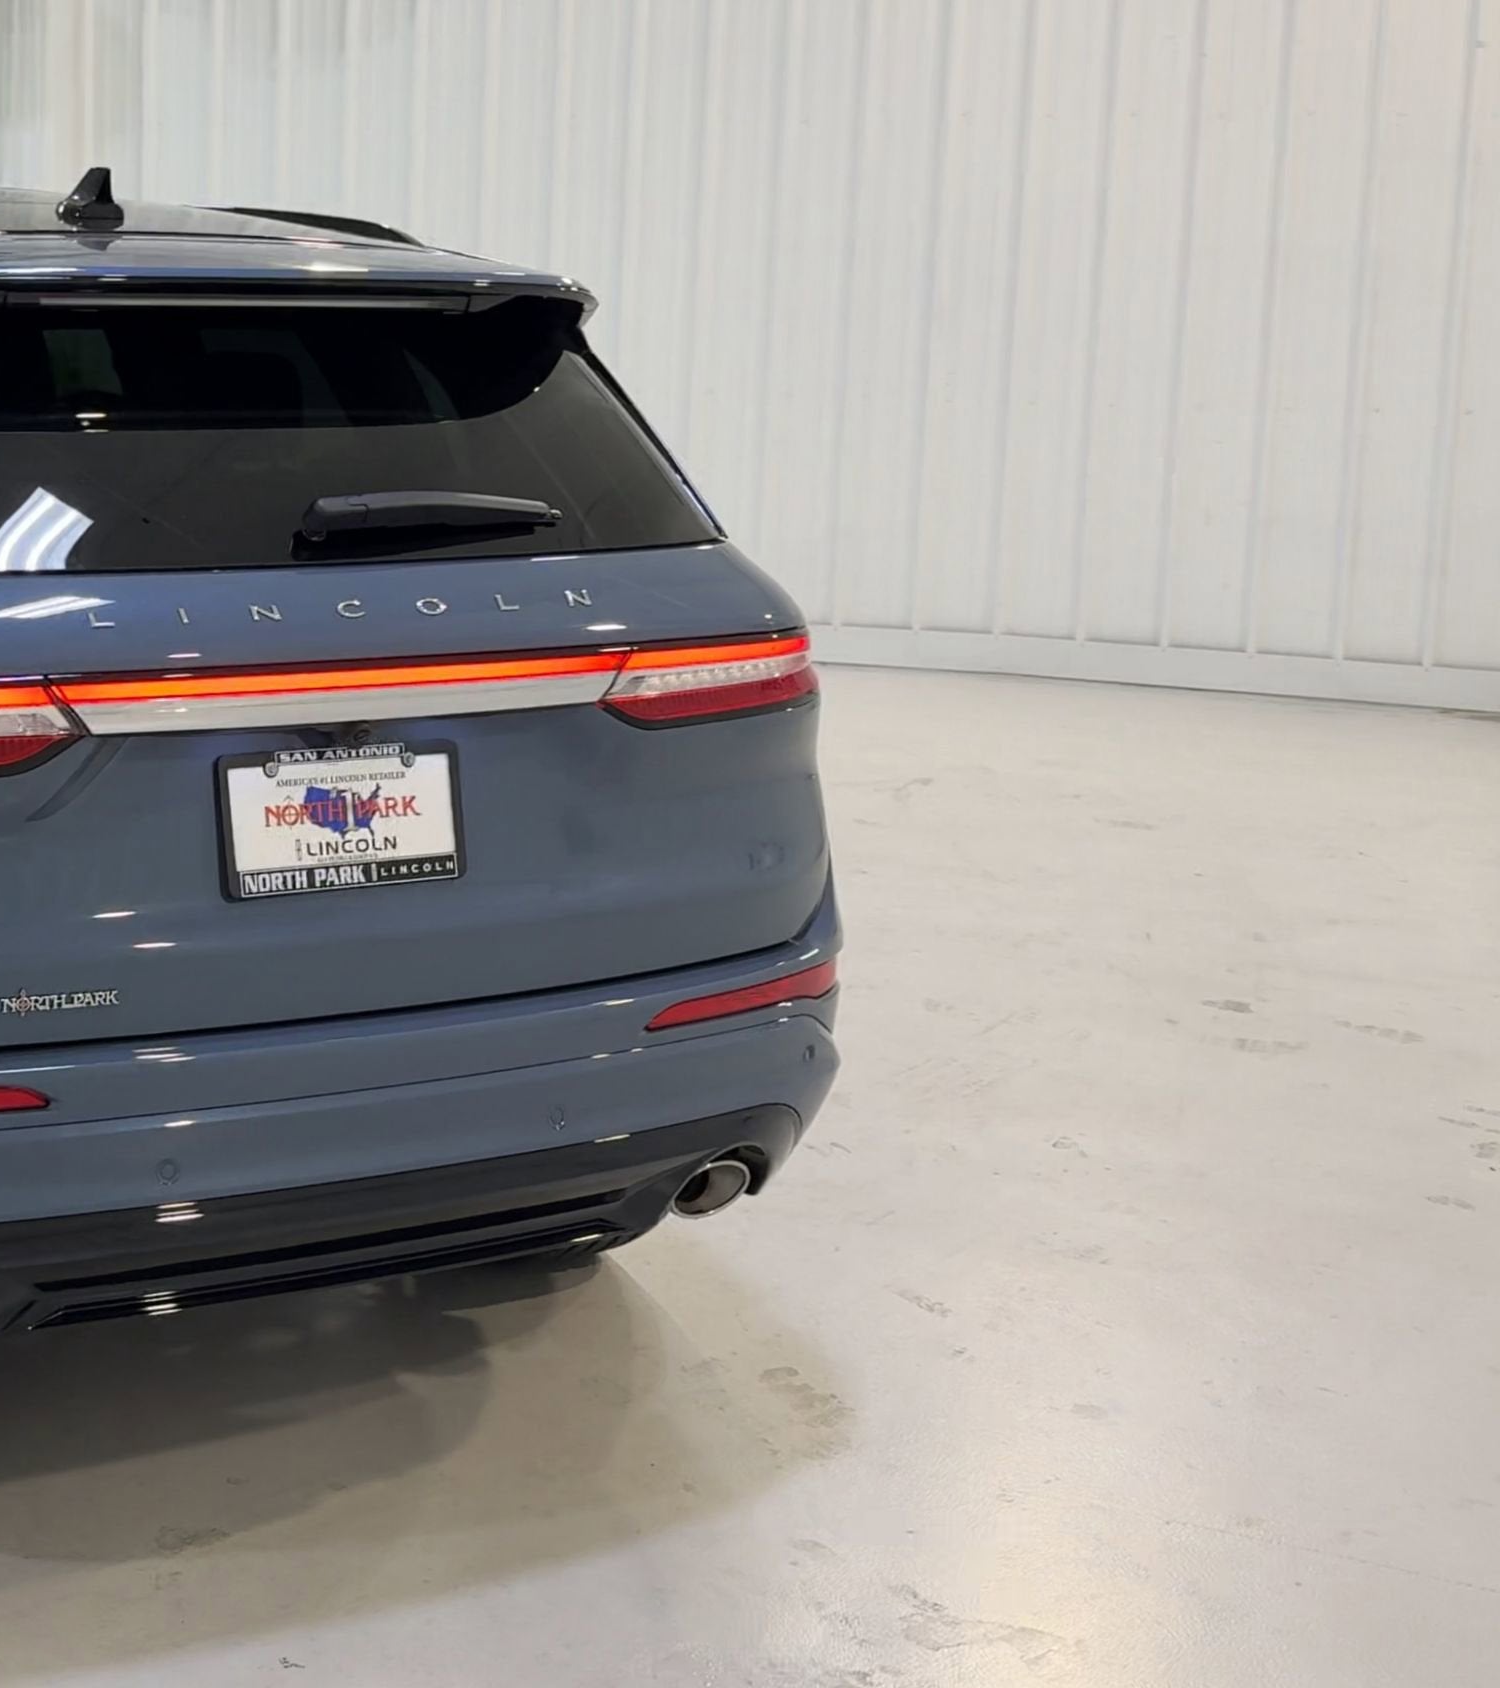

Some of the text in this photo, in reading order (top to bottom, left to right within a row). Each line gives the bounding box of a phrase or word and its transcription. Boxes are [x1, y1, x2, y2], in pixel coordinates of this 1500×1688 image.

[88, 589, 593, 629] LINCOLN
[279, 745, 400, 763] SAN ANTONIO
[330, 774, 367, 783] LINCOLN
[368, 771, 407, 781] RETAILER
[264, 795, 422, 828] NORTH PARK
[306, 836, 398, 857] LINCOLN
[243, 860, 455, 894] NORTH PARK LINCOLN
[0, 990, 120, 1013] NORTH PARK
